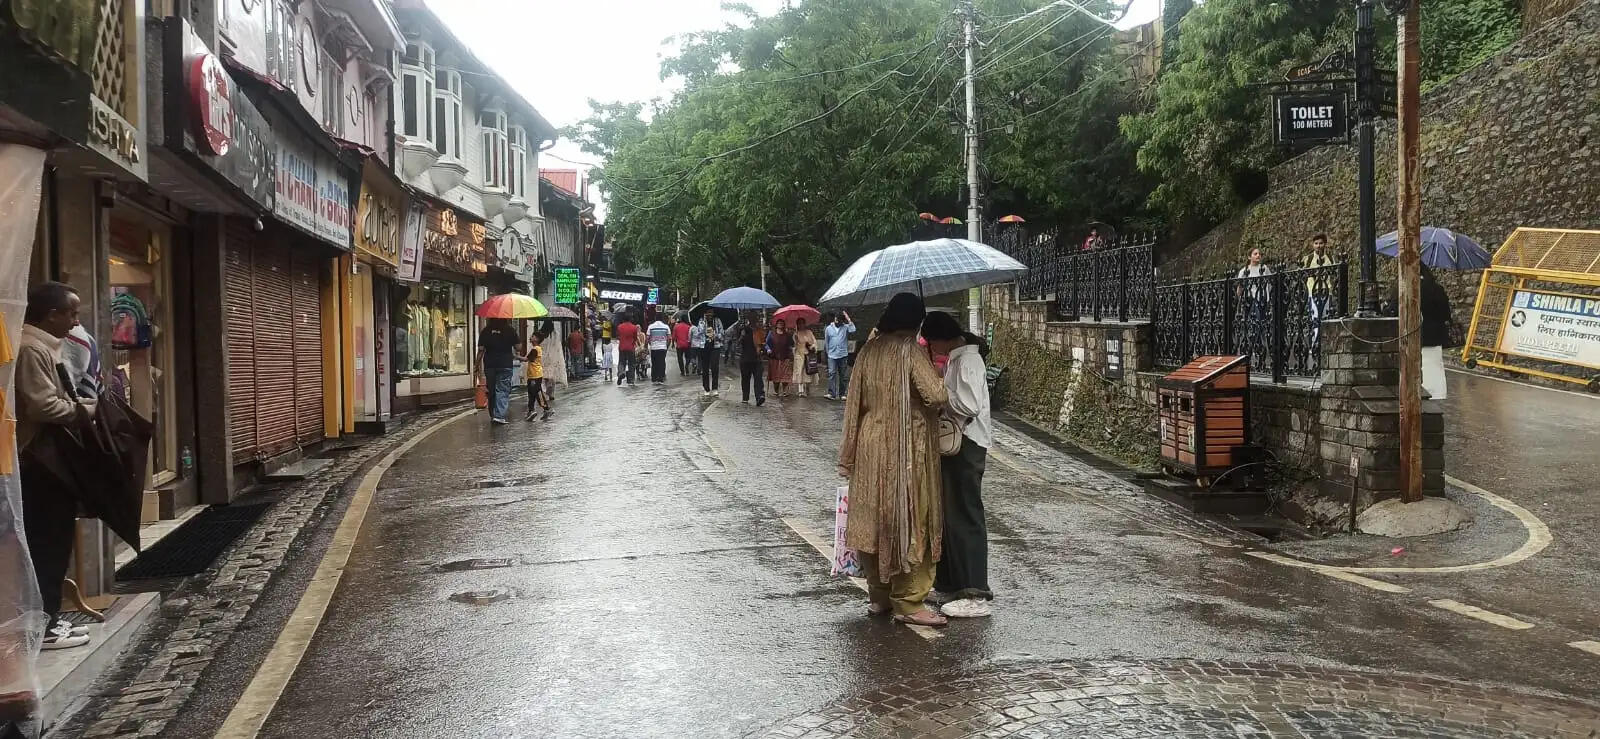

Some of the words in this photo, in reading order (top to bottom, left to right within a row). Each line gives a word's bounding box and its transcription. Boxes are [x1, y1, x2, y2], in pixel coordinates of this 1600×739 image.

[1291, 106, 1334, 119] TOILET
[1293, 121, 1305, 129] 100
[1306, 119, 1333, 129] METERS
[88, 106, 140, 164] ISHYA
[600, 290, 644, 301] SKECHERS
[1531, 294, 1582, 313] SHIMLA
[1537, 324, 1556, 335] लिए
